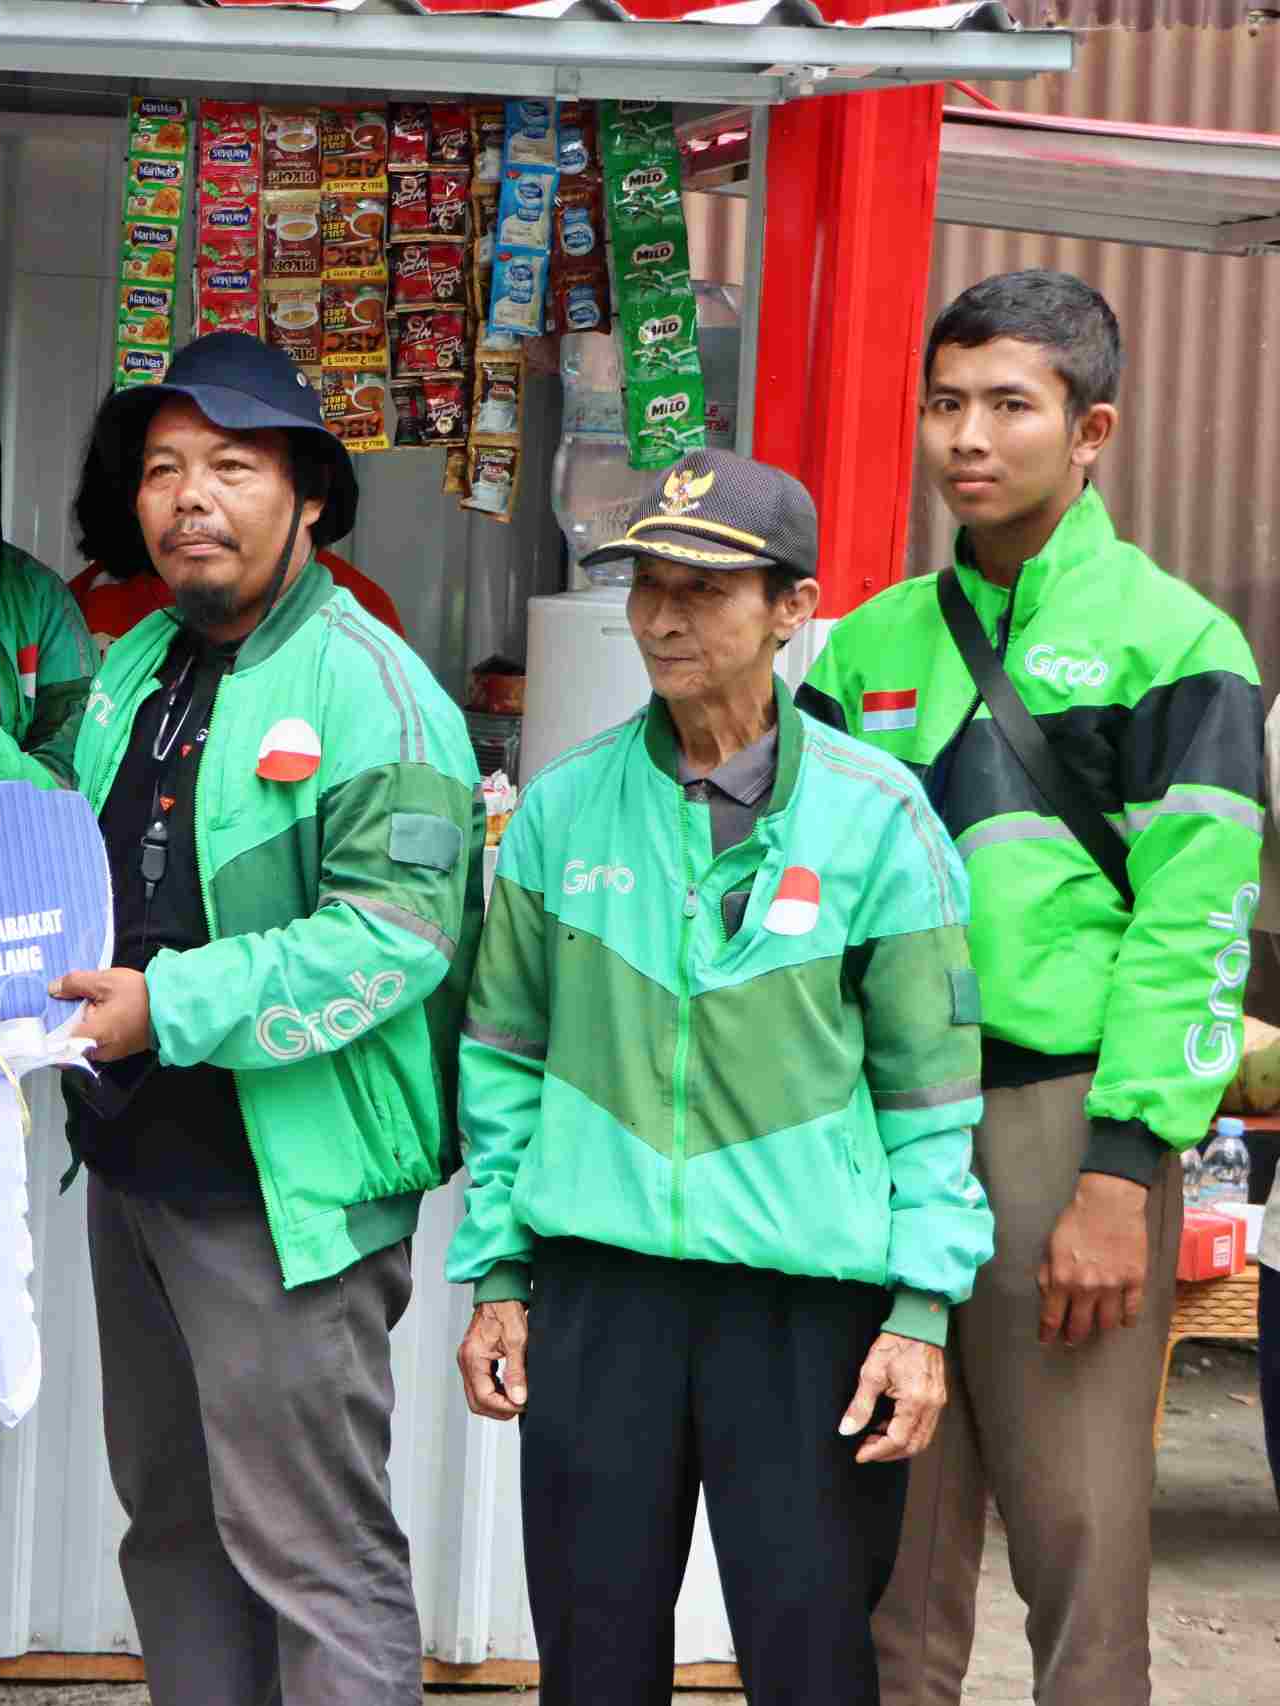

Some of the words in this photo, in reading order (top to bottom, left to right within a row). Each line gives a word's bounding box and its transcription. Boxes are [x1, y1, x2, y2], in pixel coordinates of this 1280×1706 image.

[628, 172, 663, 187] MILO
[635, 246, 671, 262] MILO
[650, 399, 686, 418] MILO
[1183, 882, 1260, 1078] Grab
[255, 969, 407, 1061] Grab
